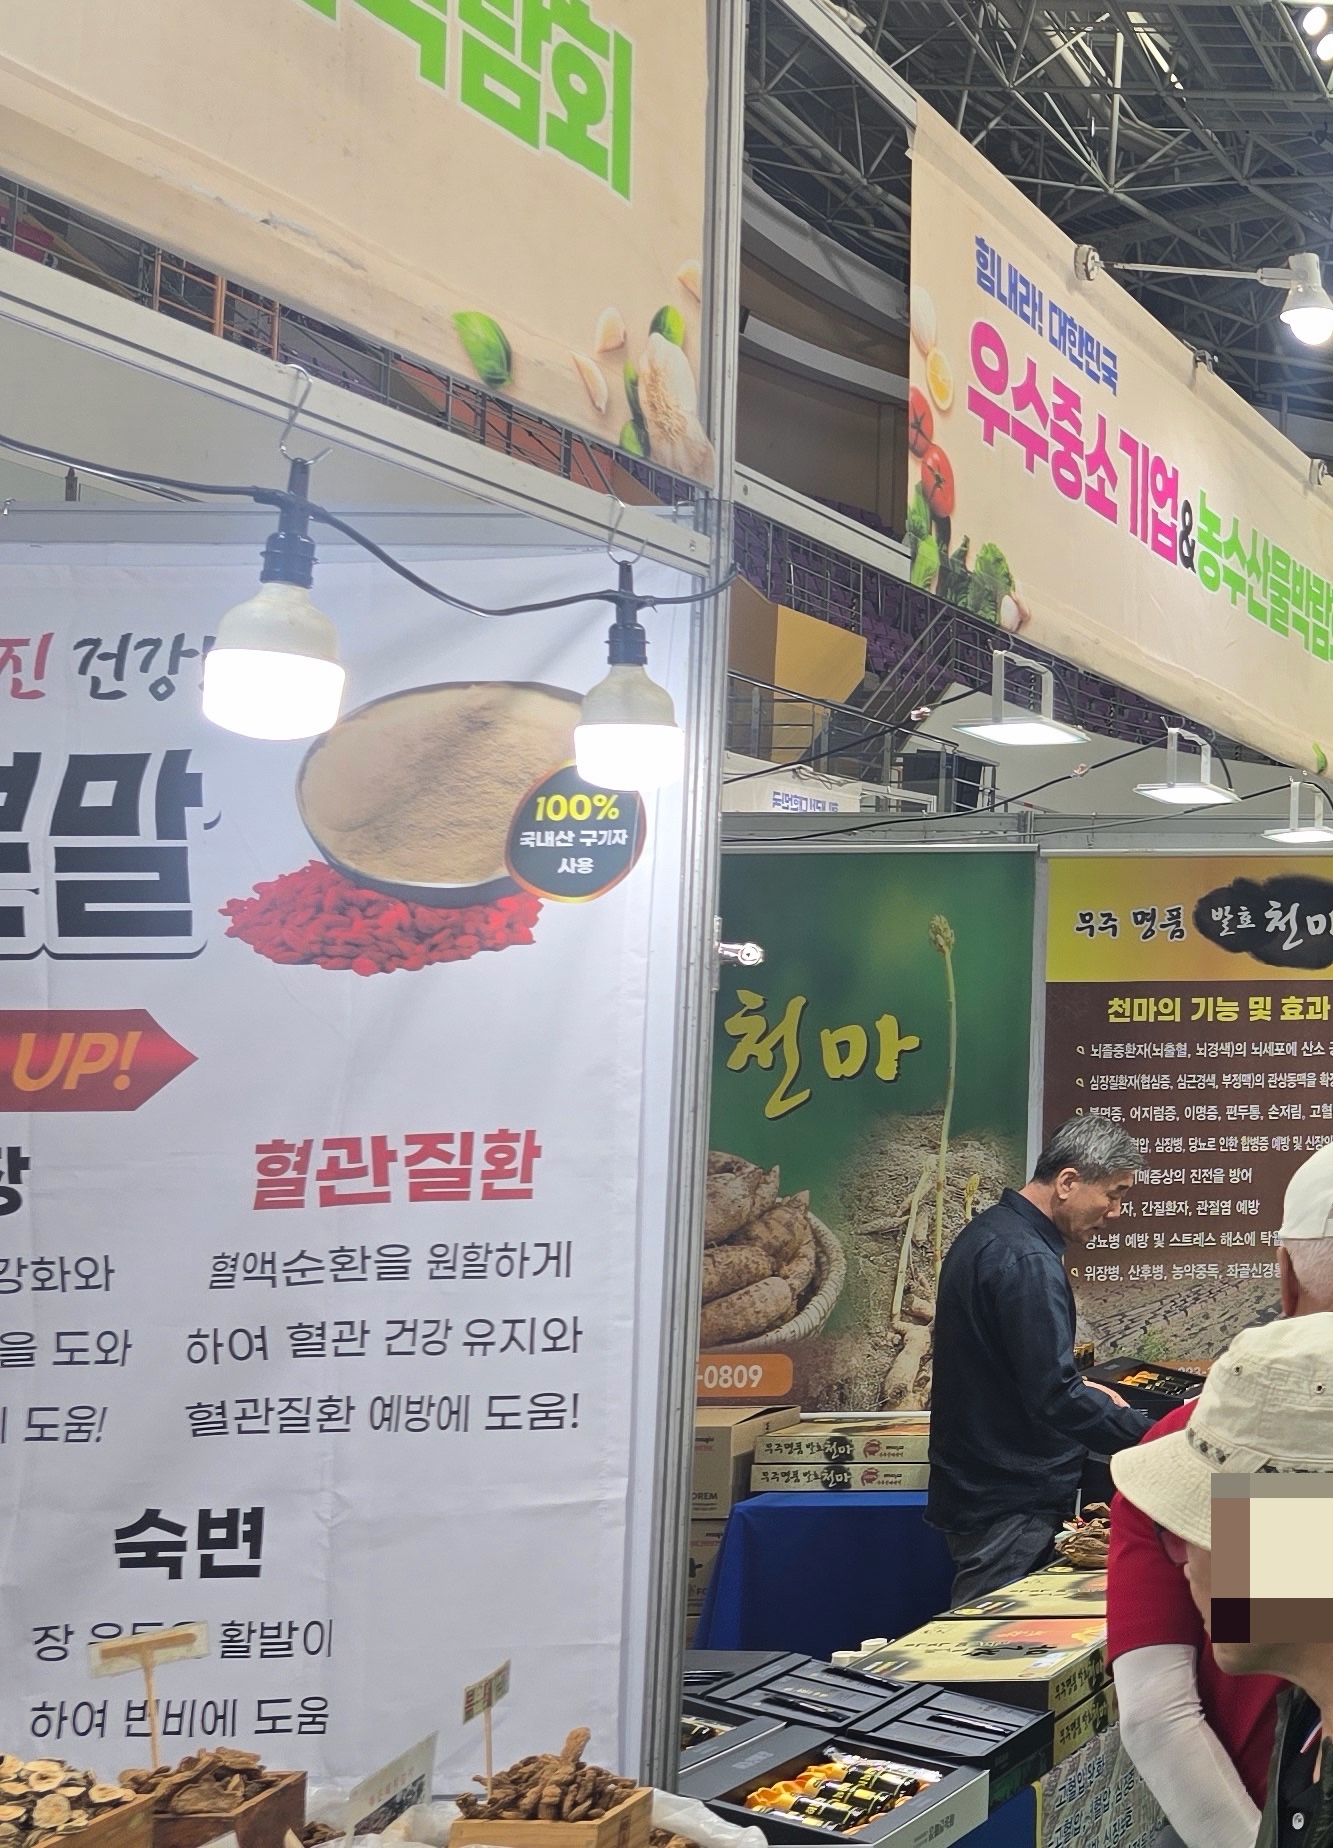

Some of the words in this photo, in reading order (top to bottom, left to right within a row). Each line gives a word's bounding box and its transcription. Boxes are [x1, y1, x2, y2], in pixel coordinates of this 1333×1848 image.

[974, 236, 1044, 336] 힘내라!
[1048, 299, 1119, 396] 대한민국
[535, 794, 620, 822] 100%
[520, 830, 574, 848] 국내산
[580, 829, 628, 847] 구기자
[557, 858, 593, 875] 사용
[1076, 911, 1118, 939] 무주
[1131, 906, 1187, 941] 명품
[1211, 905, 1256, 936] 발효
[1107, 997, 1181, 1023] 천마의
[1191, 997, 1240, 1021] 기능
[1249, 996, 1272, 1021] 및
[1280, 995, 1331, 1021] 효과
[12, 1031, 141, 1092] UP!
[724, 989, 921, 1119] 천마
[1251, 1041, 1298, 1057] 뇌세포에
[1301, 1040, 1325, 1055] 산소
[1176, 1075, 1219, 1090] 심근경색,
[1130, 1107, 1180, 1121] 어지럼증,
[1184, 1106, 1220, 1121] 이명증,
[1226, 1105, 1264, 1120] 편두통,
[1268, 1104, 1306, 1120] 손저림,
[1155, 1137, 1185, 1153] 심장병,
[1188, 1137, 1216, 1151] 당뇨로
[1219, 1136, 1238, 1151] 인한
[1271, 1136, 1290, 1151] 예방
[1292, 1136, 1302, 1151] 및
[251, 1128, 542, 1211] 혈관질환
[1134, 1169, 1185, 1185] 매증상의
[1189, 1168, 1225, 1184] 진전을
[1228, 1168, 1253, 1183] 방어
[1141, 1201, 1192, 1217] 간질환자,
[1196, 1200, 1231, 1215] 관절염
[1235, 1200, 1260, 1215] 예방
[1125, 1233, 1149, 1248] 예방
[1153, 1233, 1165, 1248] 및
[1169, 1232, 1216, 1246] 스트레스
[1220, 1231, 1256, 1246] 해소에
[208, 1242, 413, 1291] 혈액순환을
[1084, 1265, 1123, 1282] 위장병,
[1127, 1265, 1167, 1280] 산후병,
[1171, 1264, 1223, 1280] 농약중독,
[53, 1329, 133, 1368] 도와
[186, 1325, 269, 1365] 하여
[286, 1320, 370, 1358] 혈관
[385, 1319, 453, 1357] 건강
[460, 1316, 583, 1356] 유지와
[25, 1405, 107, 1444] 도움!
[185, 1395, 355, 1438] 혈관질환
[369, 1394, 471, 1434] 예방에
[485, 1392, 579, 1432] 도움!
[114, 1506, 264, 1580] 숙변
[32, 1624, 74, 1662] 장
[219, 1618, 335, 1659] 활발이
[29, 1700, 107, 1739] 하여
[254, 1696, 329, 1736] 도움
